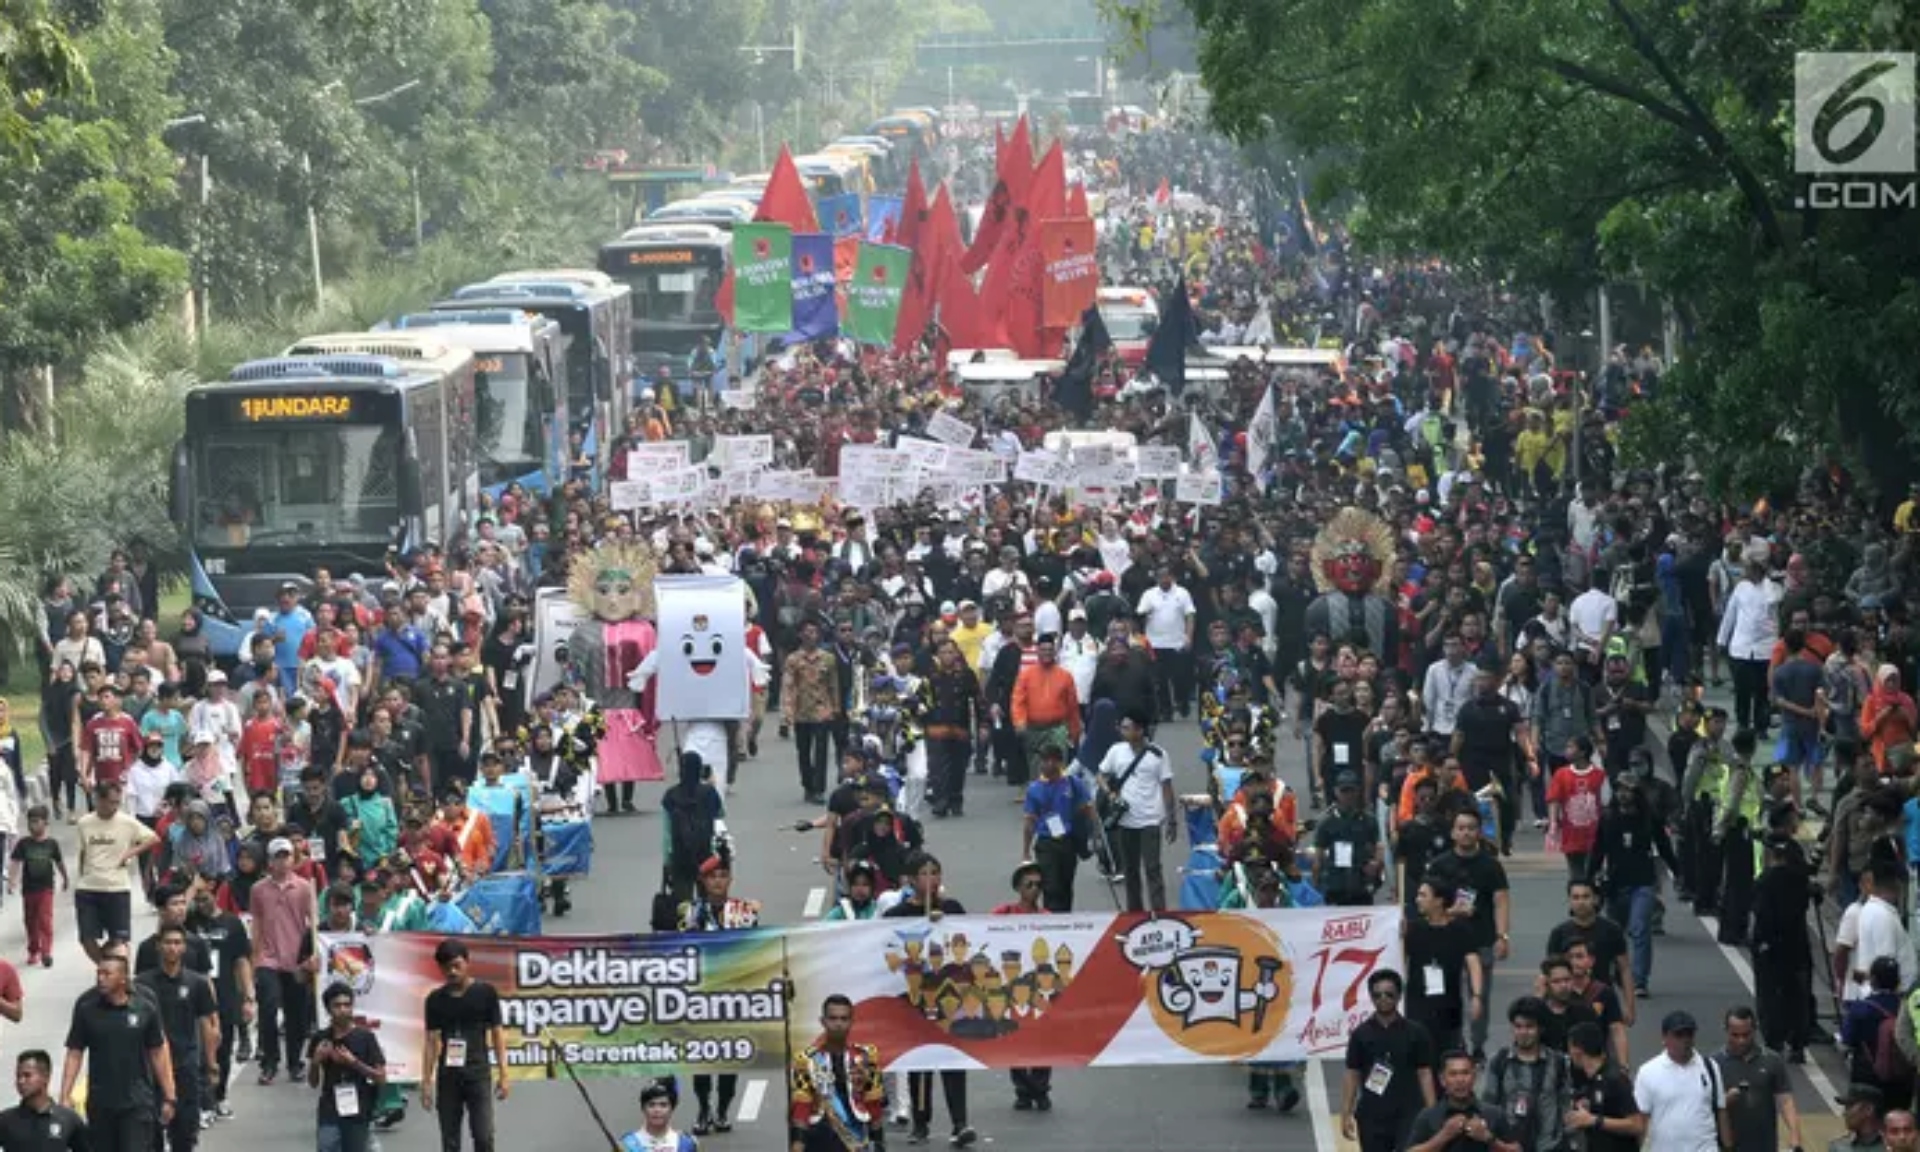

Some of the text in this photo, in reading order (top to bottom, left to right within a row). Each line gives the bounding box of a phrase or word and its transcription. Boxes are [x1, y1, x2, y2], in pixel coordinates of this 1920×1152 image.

[517, 946, 699, 987] Deklarasi
[1307, 944, 1388, 1012] 17
[498, 981, 784, 1035] mpanye Damai
[564, 1041, 679, 1064] Serentak
[685, 1039, 753, 1060] 2019
